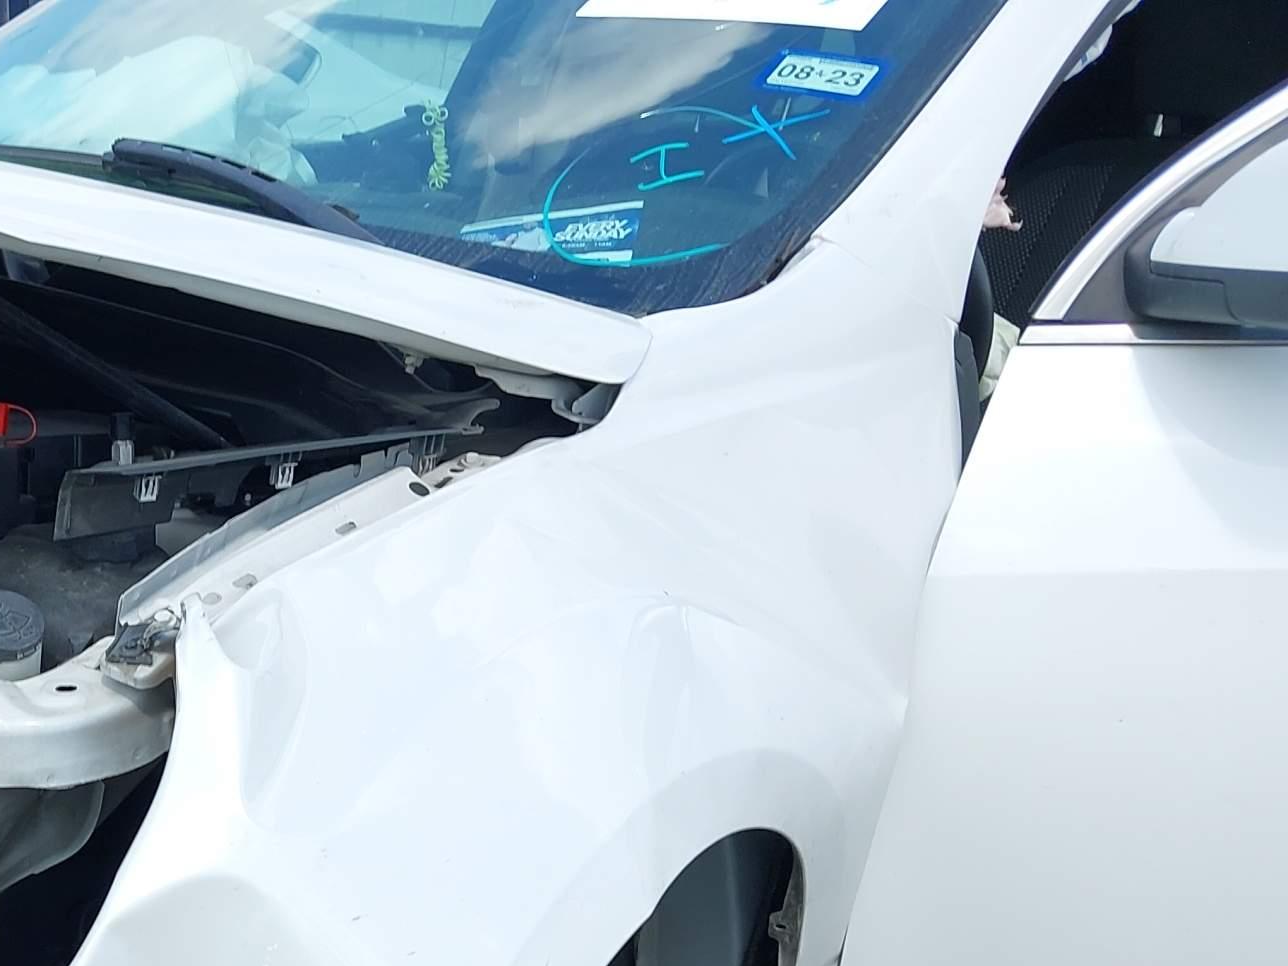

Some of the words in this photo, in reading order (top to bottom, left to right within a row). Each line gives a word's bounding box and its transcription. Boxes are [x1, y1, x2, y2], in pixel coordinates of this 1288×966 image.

[777, 63, 815, 80] 08
[824, 69, 864, 87] 23
[553, 227, 633, 241] SUNDAY
